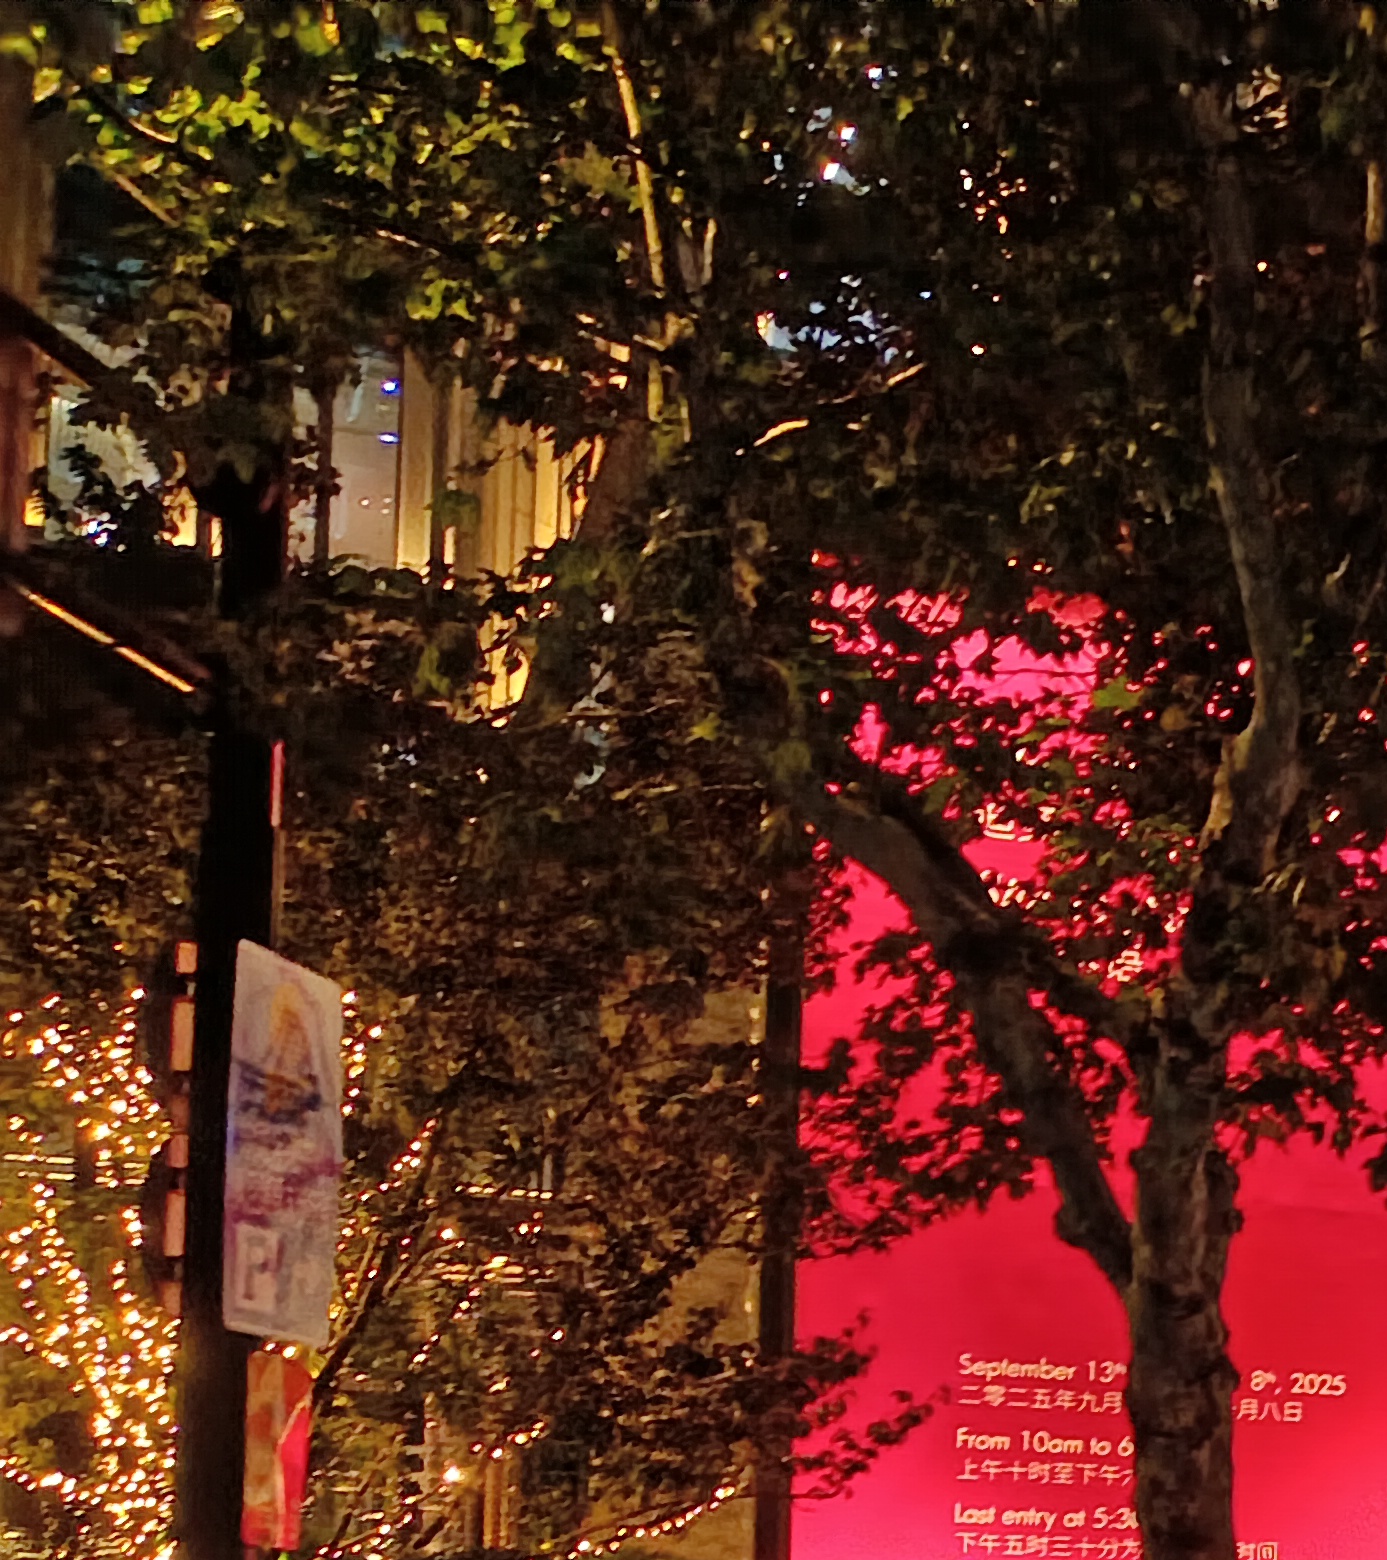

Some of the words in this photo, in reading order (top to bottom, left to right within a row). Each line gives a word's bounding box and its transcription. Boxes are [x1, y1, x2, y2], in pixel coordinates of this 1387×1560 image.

[959, 1353, 1077, 1382] September
[1290, 1372, 1347, 1396] 2025
[958, 1385, 1123, 1415] 二零二五年九月
[1232, 1398, 1303, 1422] 月八日
[956, 1427, 1011, 1451] From
[1021, 1430, 1084, 1455] 10am
[1090, 1437, 1112, 1456] to
[954, 1502, 996, 1525] Last
[1002, 1507, 1057, 1532] entry
[1063, 1508, 1087, 1528] at
